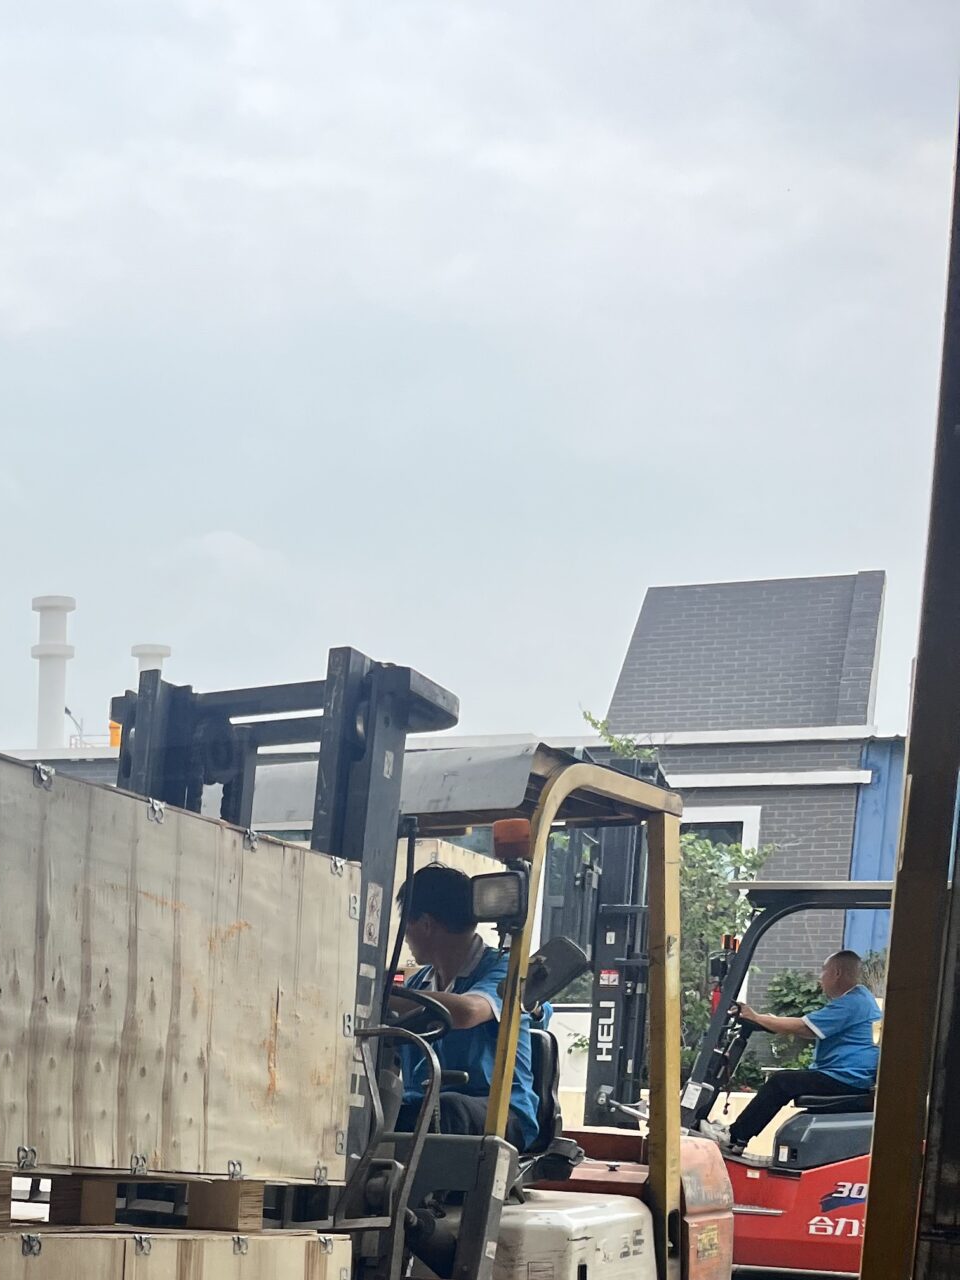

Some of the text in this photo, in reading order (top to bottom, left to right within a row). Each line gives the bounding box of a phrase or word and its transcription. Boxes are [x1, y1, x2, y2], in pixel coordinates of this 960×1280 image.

[596, 1000, 616, 1062] HELI
[831, 1181, 868, 1199] 30
[808, 1216, 865, 1237] 合力
